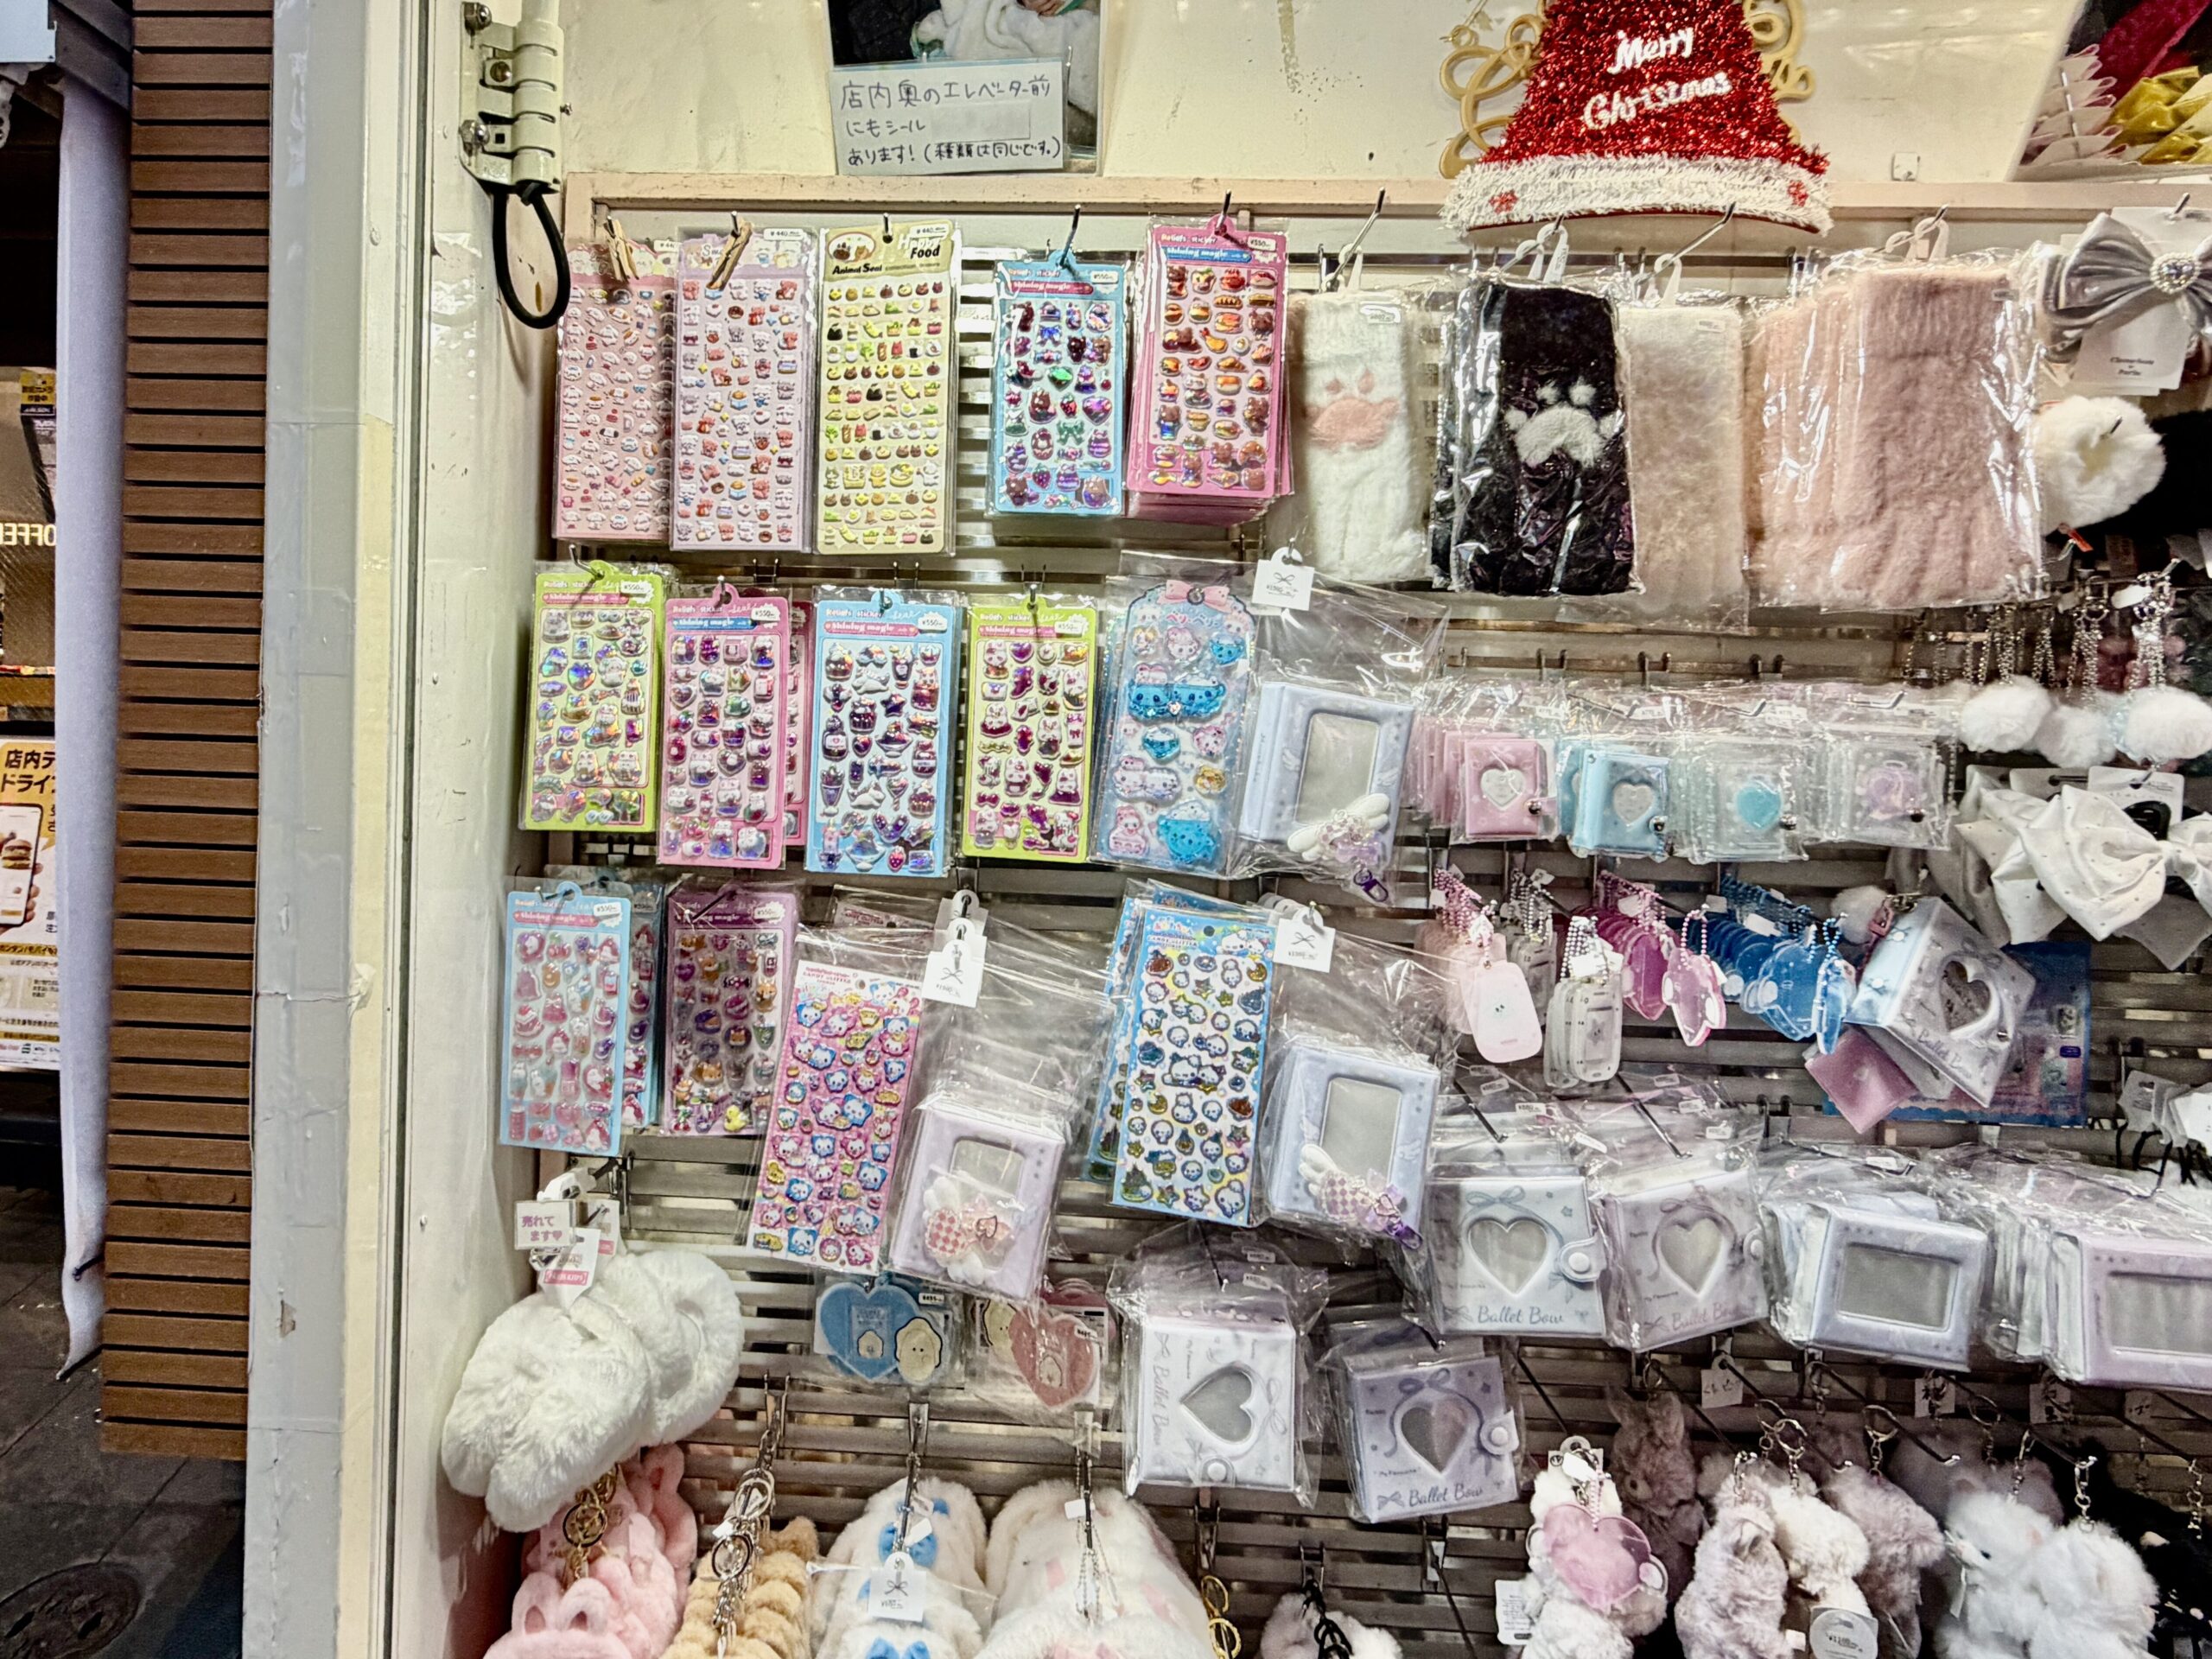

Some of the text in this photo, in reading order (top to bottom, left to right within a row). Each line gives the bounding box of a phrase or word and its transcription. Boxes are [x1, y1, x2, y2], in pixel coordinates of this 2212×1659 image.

[1606, 27, 1694, 74] Merry
[841, 74, 1051, 110] 店内奥のエレベーター前
[1583, 71, 1733, 130] Christmas
[846, 119, 926, 136] にもシール
[910, 245, 940, 259] Food
[1, 773, 55, 793] ドライ
[521, 1215, 555, 1227] 売れて
[1478, 1305, 1565, 1325] Ballet Bow
[1408, 1482, 1484, 1507] Ballet Bow
